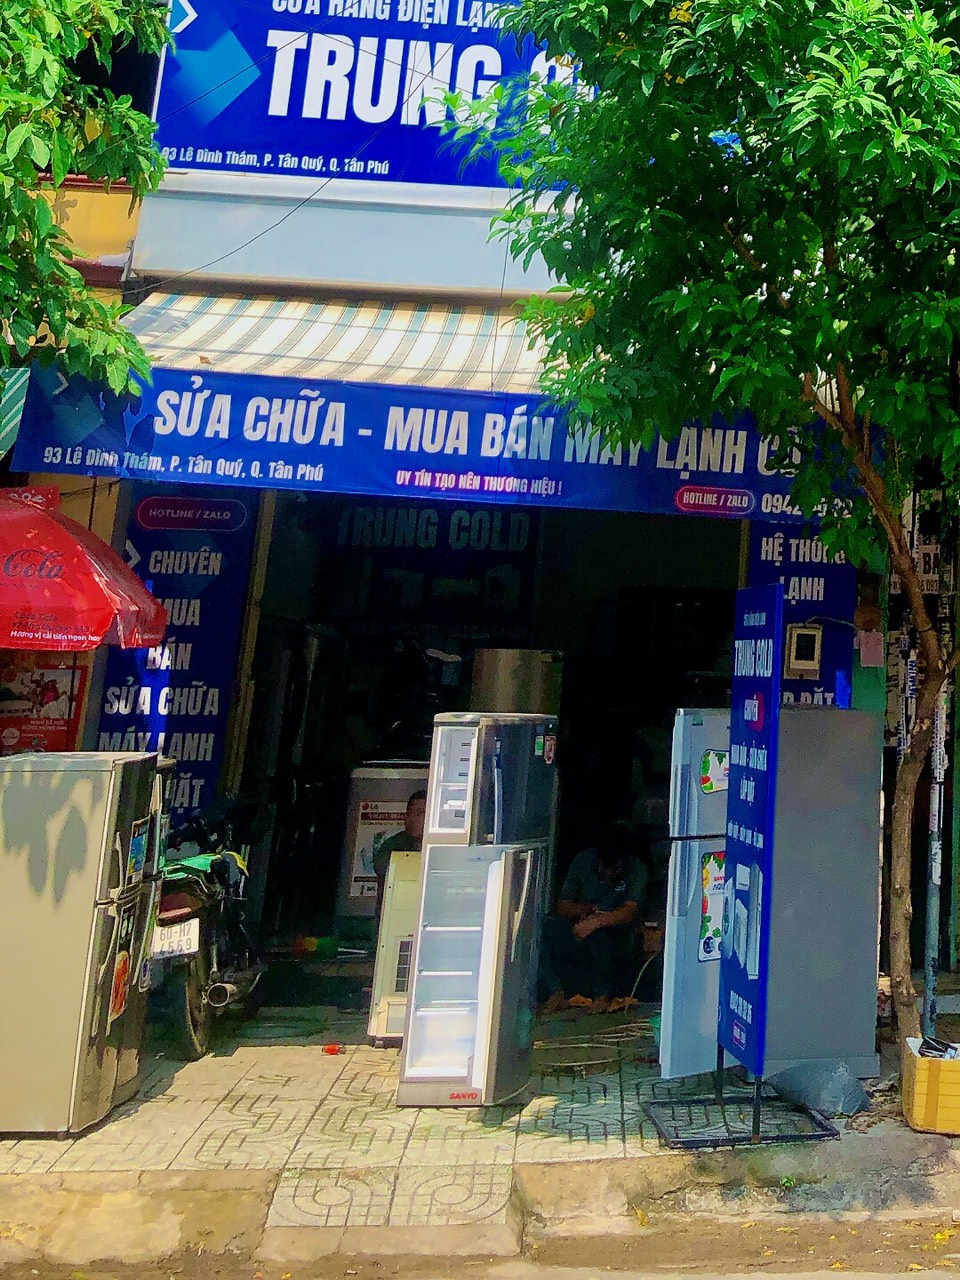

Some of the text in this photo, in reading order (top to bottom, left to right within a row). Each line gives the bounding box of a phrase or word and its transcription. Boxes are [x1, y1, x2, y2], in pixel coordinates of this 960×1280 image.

[266, 29, 502, 131] TRUNG
[179, 147, 194, 162] Lê
[195, 148, 223, 164] Đình
[263, 153, 275, 167] P.
[278, 153, 299, 169] Tân
[329, 157, 341, 172] Q.
[343, 158, 365, 174] Tân
[367, 158, 390, 175] Phú
[153, 375, 232, 439] SỬA
[243, 388, 346, 447] CHỮA
[383, 406, 469, 456] MUA
[480, 403, 555, 461] BÁN
[43, 446, 62, 464] 93
[65, 447, 82, 465] Lê
[169, 455, 182, 472] P.
[188, 455, 212, 475] Tân
[250, 461, 264, 478] Q.
[267, 461, 293, 479] Tân
[296, 462, 324, 482] Phú
[396, 470, 411, 486] UY
[414, 468, 431, 487] TÍN
[435, 472, 456, 491] TẠO
[458, 471, 481, 491] NÊN
[530, 476, 556, 498] HIỆU
[682, 491, 718, 506] HOTLINE
[727, 494, 749, 508] ZALO
[149, 508, 194, 519] HOTLINE
[203, 510, 231, 520] ZALO
[449, 509, 531, 551] COLD
[149, 545, 223, 576] CHUYÊN
[760, 532, 785, 567] HỆ
[146, 635, 192, 670] BÁN
[105, 676, 220, 716] SỬA CHỮA
[98, 725, 152, 752] MÁY
